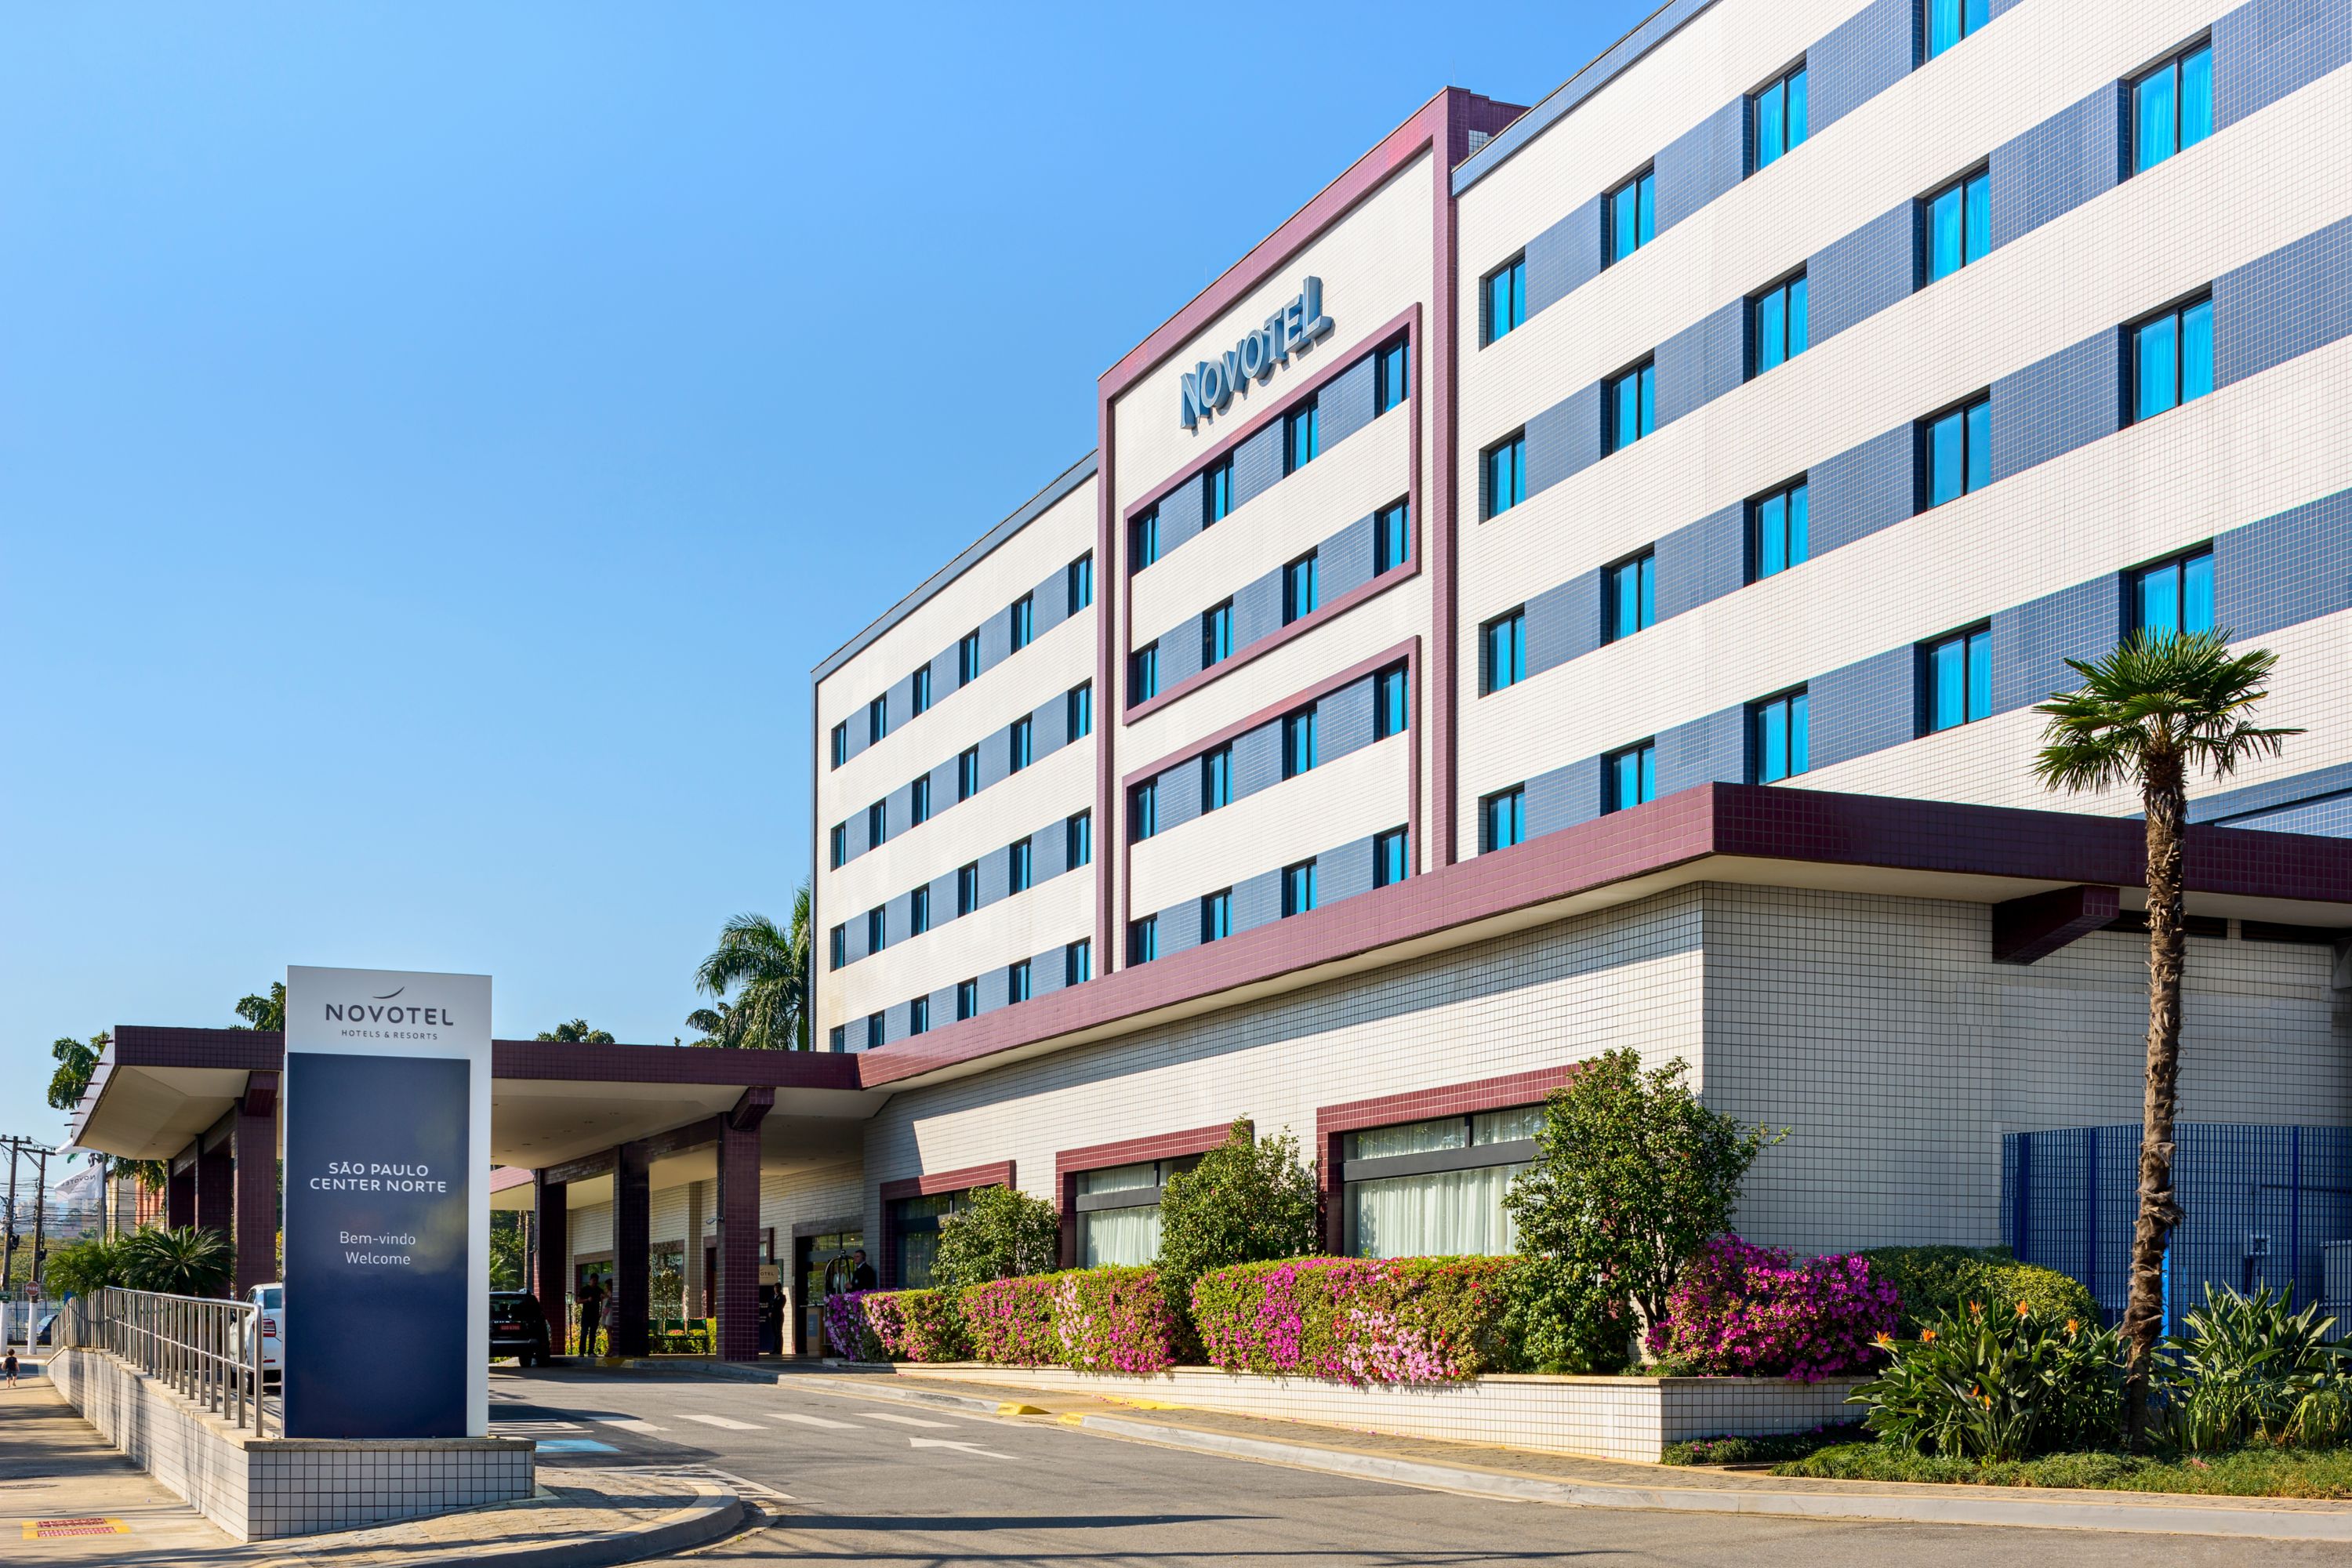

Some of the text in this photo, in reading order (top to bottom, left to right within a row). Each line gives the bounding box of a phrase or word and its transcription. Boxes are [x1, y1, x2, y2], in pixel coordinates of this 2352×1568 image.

[1180, 275, 1334, 430] NOVOTEL
[325, 1004, 454, 1026] NOVOTEL
[341, 1029, 381, 1038] HOTELS
[394, 1032, 438, 1040] RESORTS
[328, 1161, 429, 1177] SÃO PAULO
[310, 1178, 447, 1193] CENTER NORTE
[339, 1231, 416, 1246] Bem-vindo
[345, 1251, 411, 1265] Welcome
